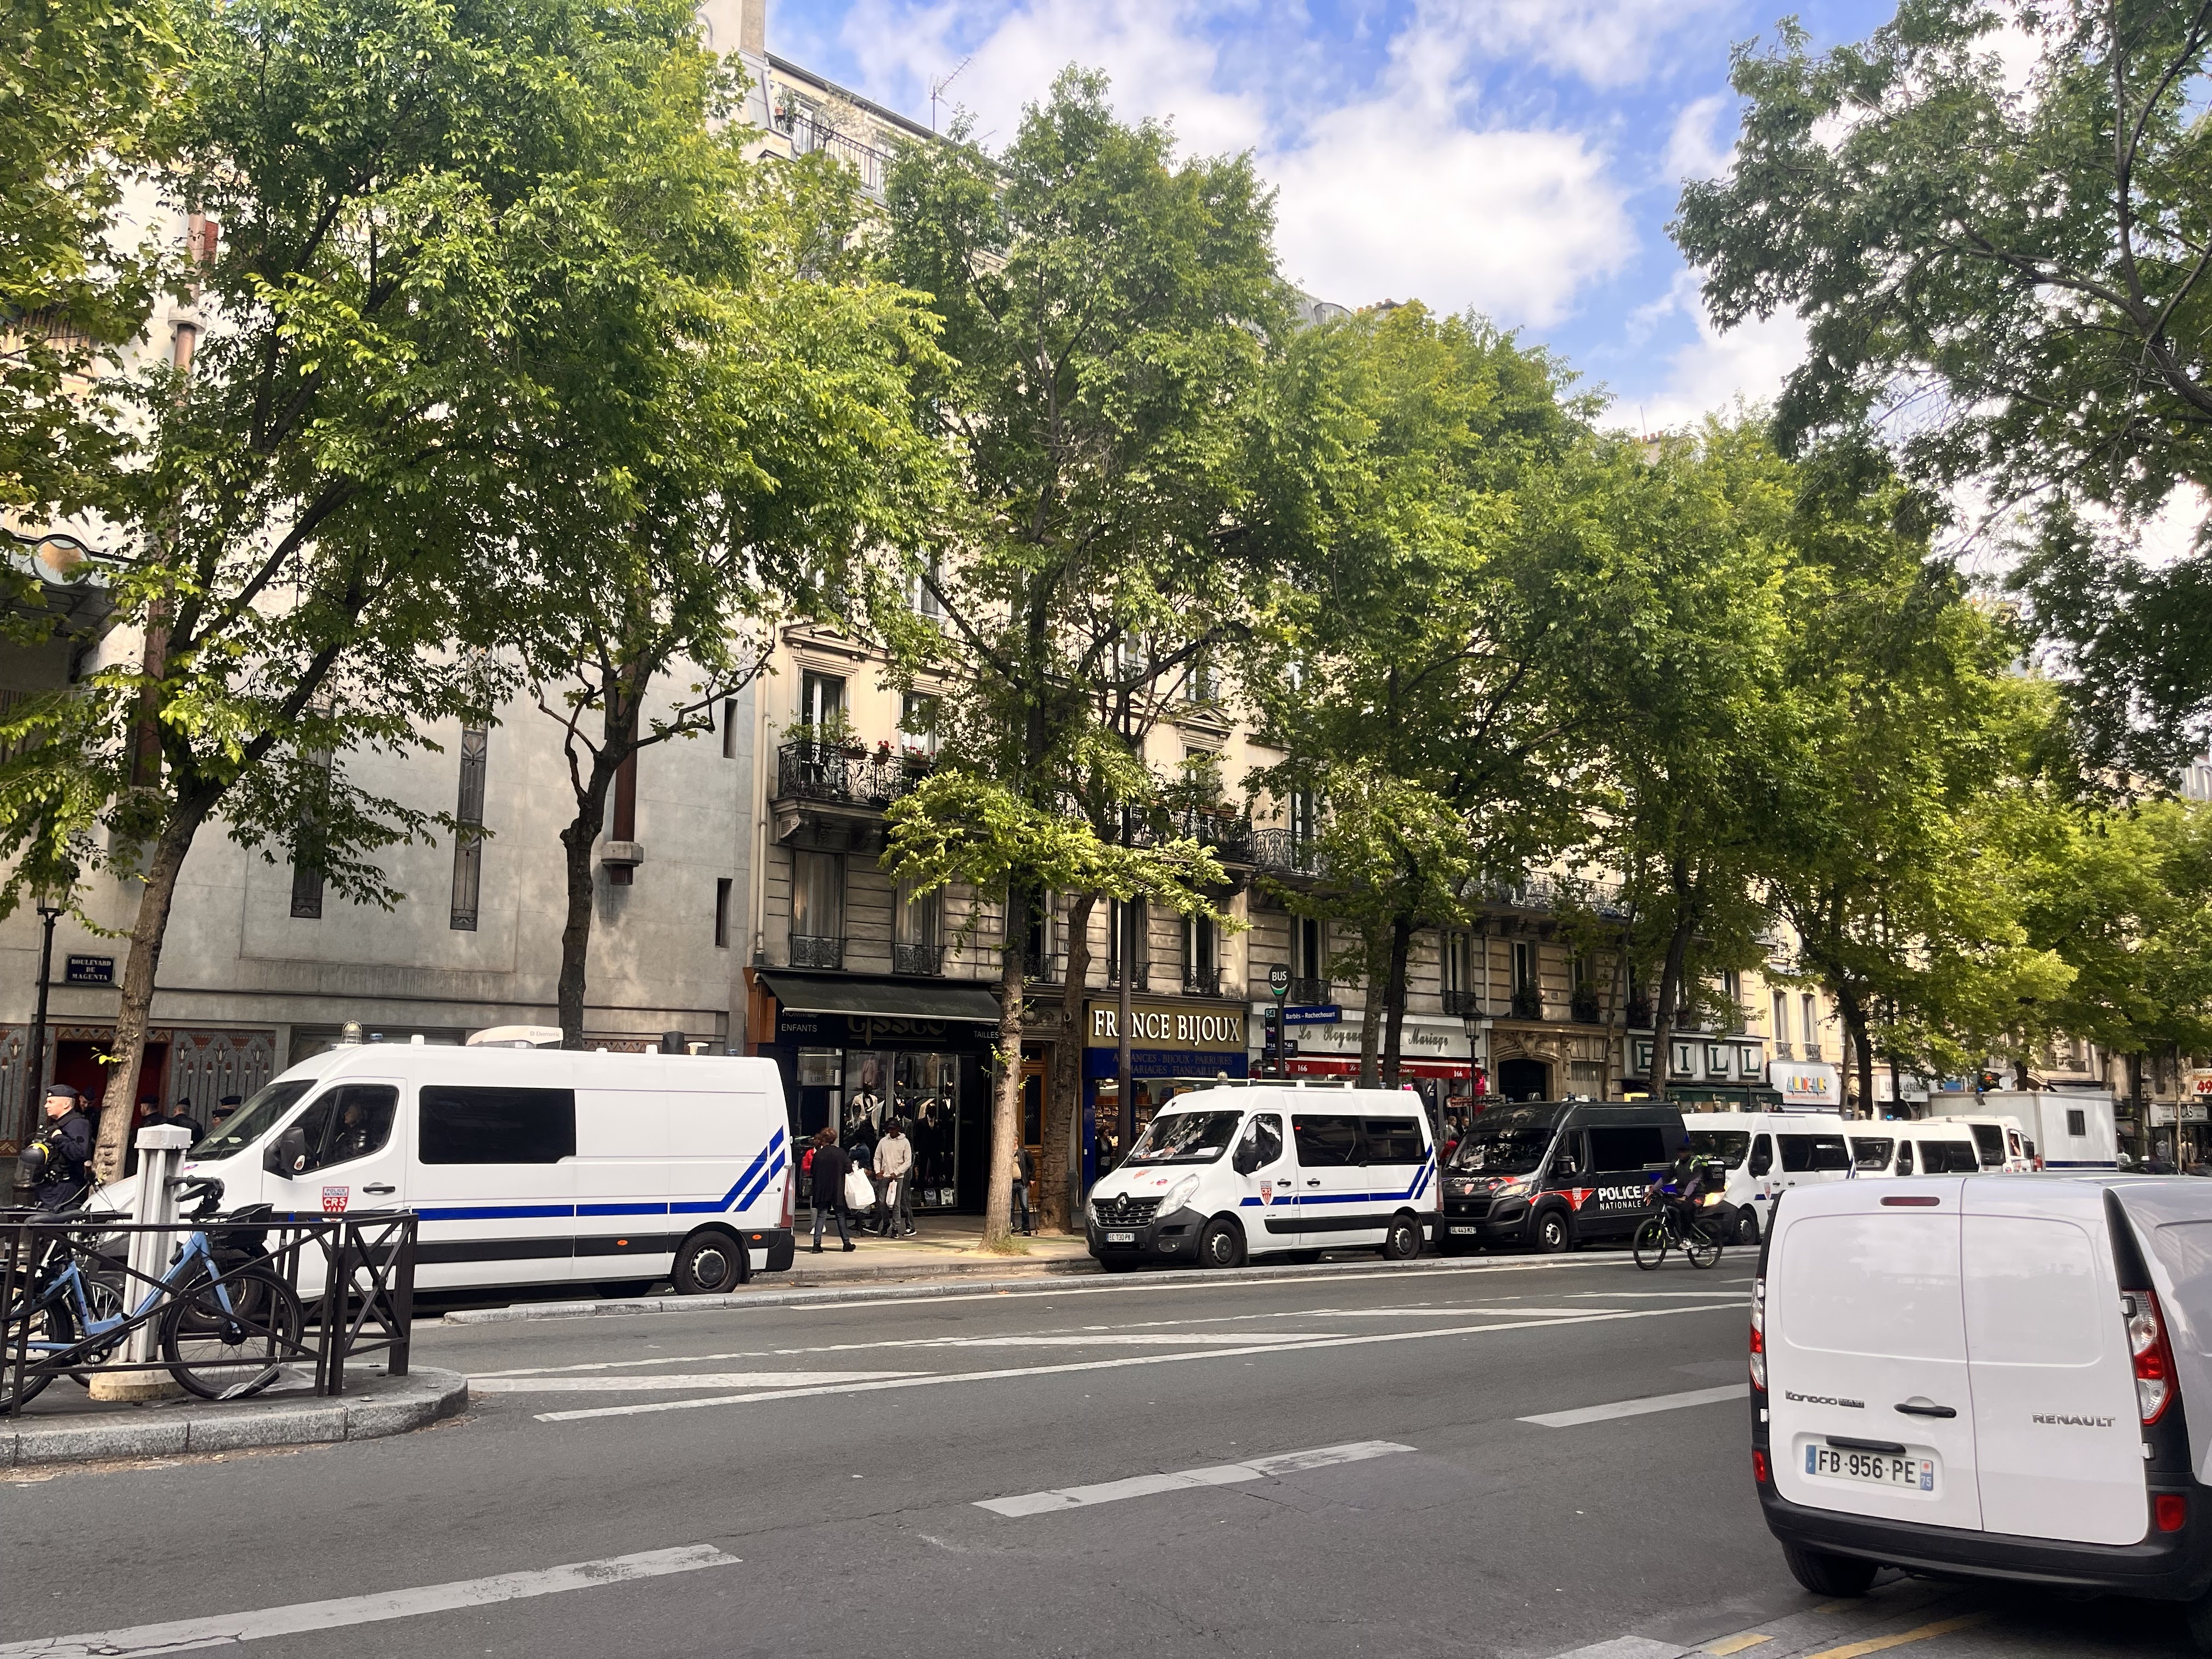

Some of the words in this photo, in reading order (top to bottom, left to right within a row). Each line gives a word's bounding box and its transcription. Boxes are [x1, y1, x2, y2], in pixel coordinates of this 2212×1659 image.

[1272, 971, 1287, 981] BUS
[781, 1023, 818, 1032] ENFANTS
[1094, 1010, 1171, 1040] FRNCE
[1177, 1014, 1240, 1046] BIJOUX
[973, 1031, 999, 1039] TAILLES
[1408, 1028, 1448, 1053] Mariage
[1598, 1186, 1641, 1201] POLICE
[324, 1197, 346, 1207] CRS
[1600, 1200, 1641, 1210] NATIONALE
[1785, 1390, 1838, 1405] Kangoo
[2032, 1412, 2115, 1427] RENAULT
[1819, 1450, 1916, 1483] FB-956-PE
[1921, 1476, 1932, 1487] 75
